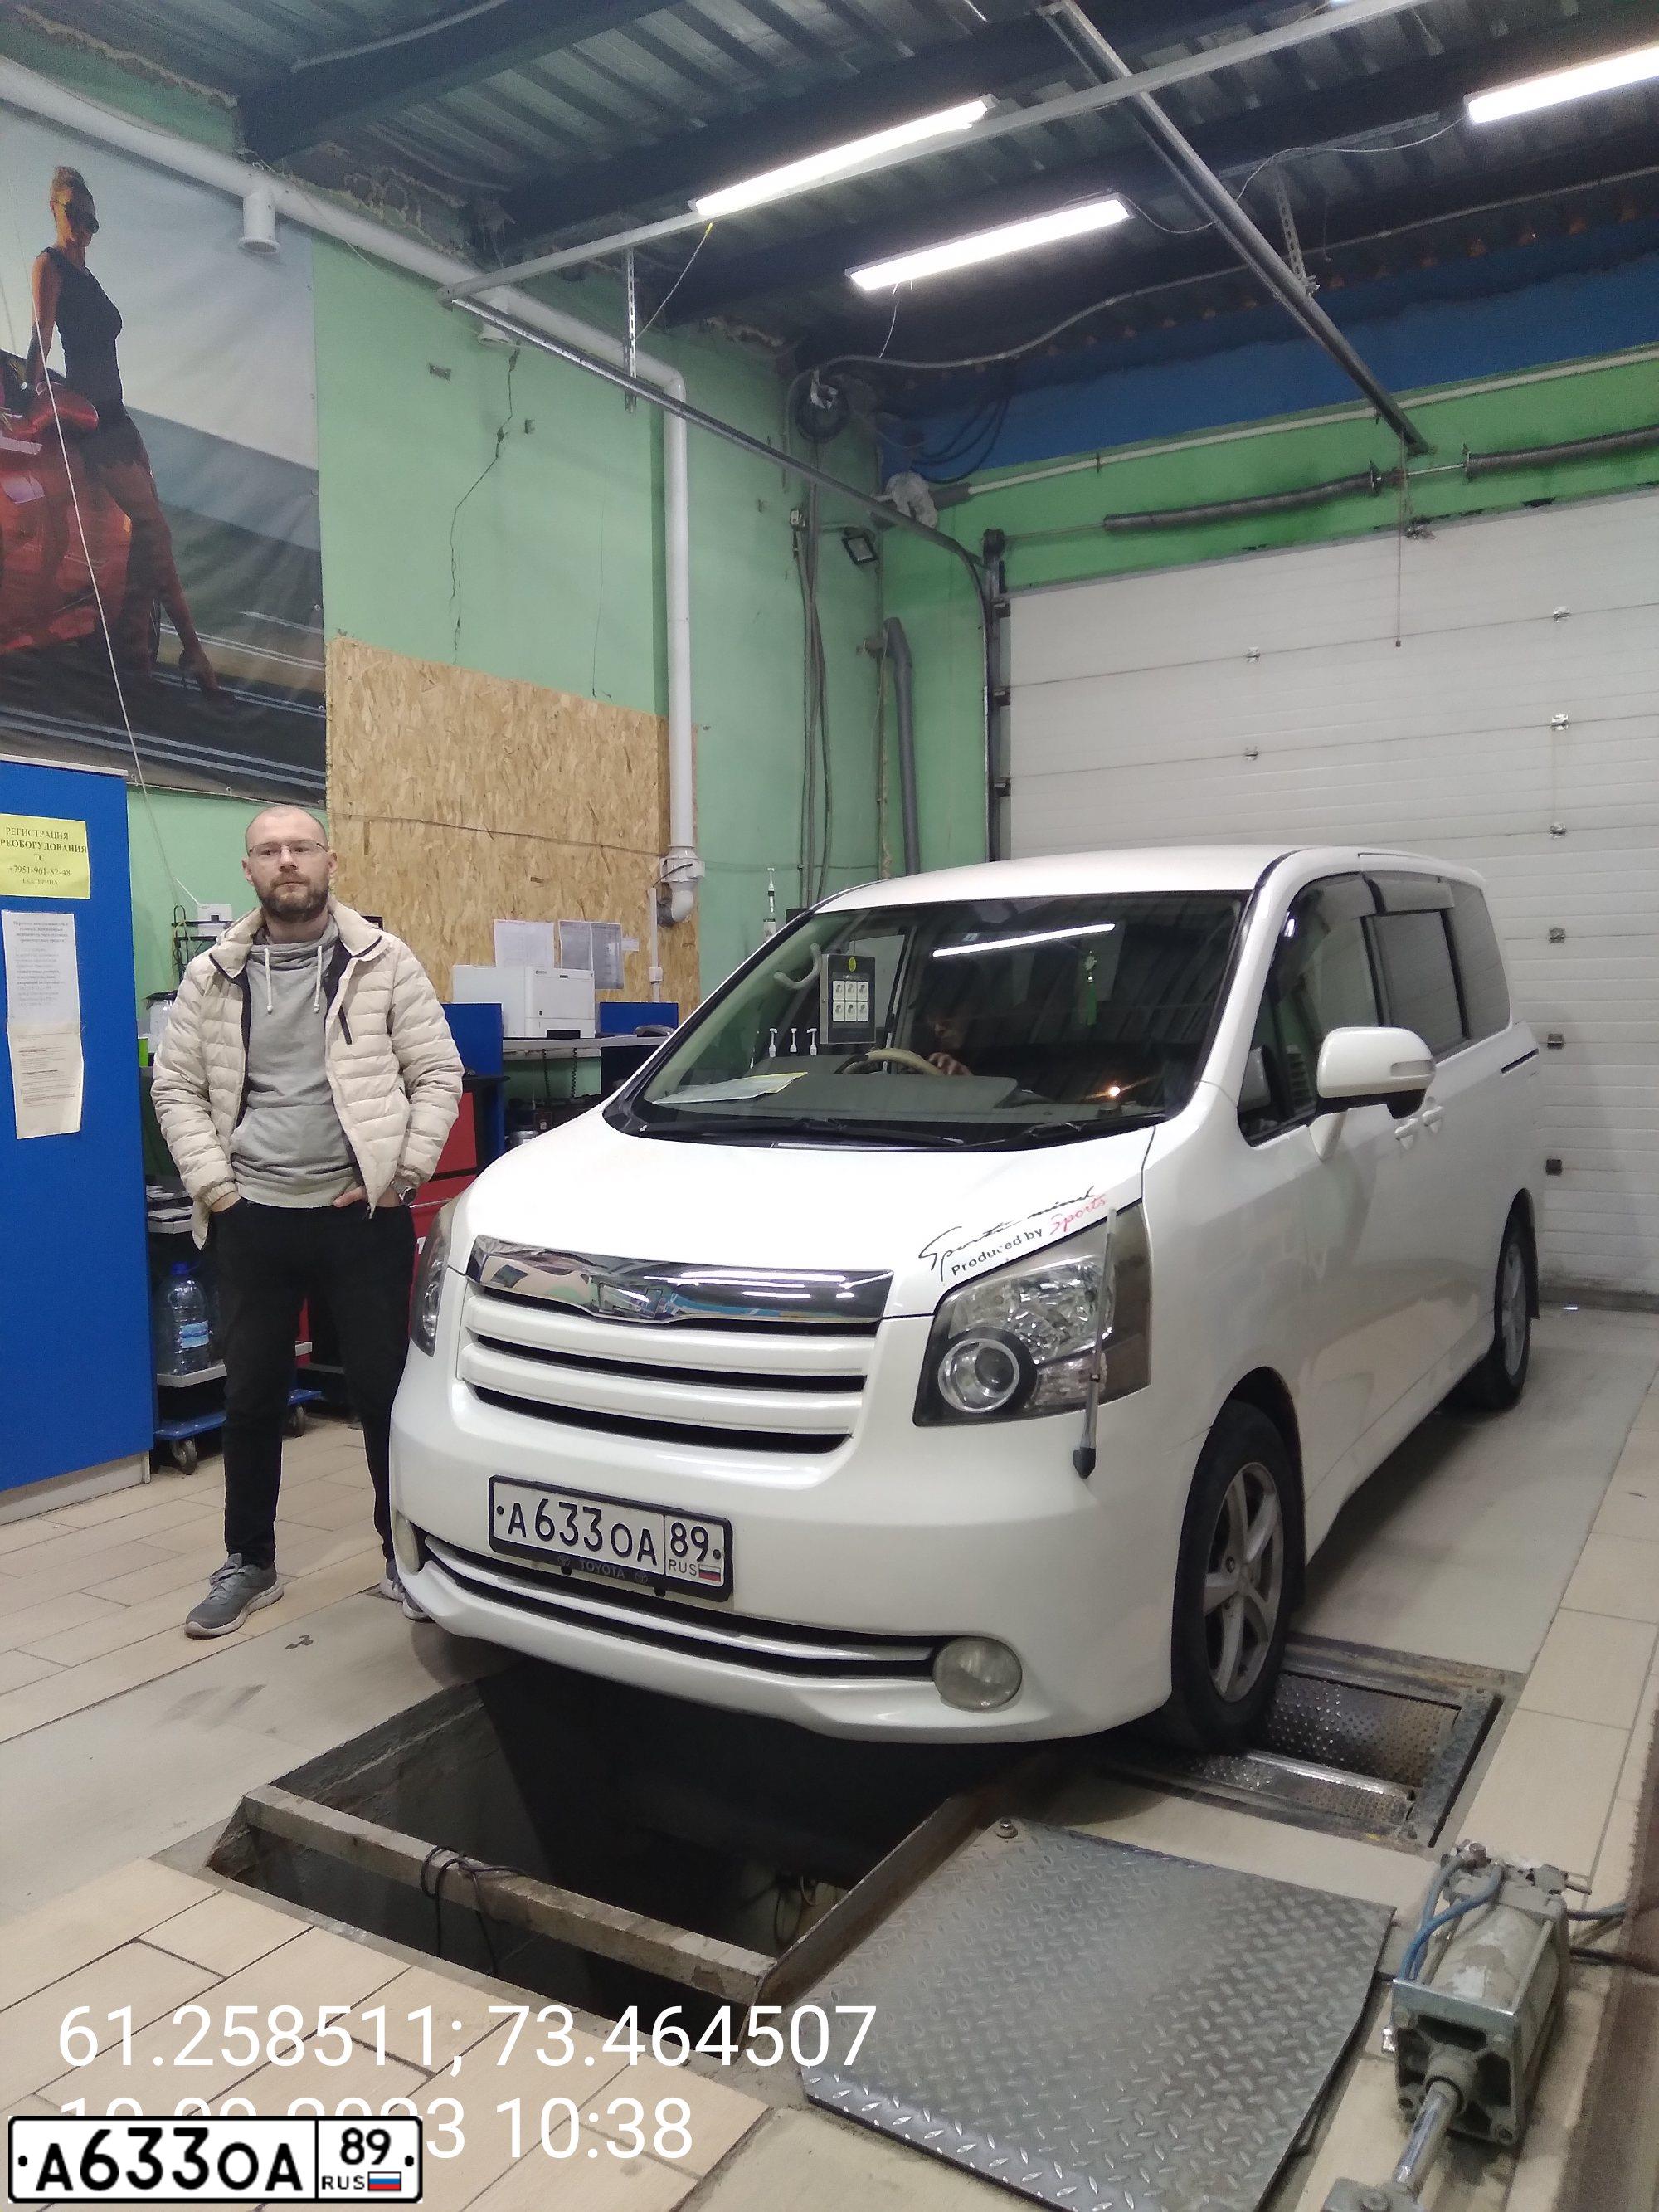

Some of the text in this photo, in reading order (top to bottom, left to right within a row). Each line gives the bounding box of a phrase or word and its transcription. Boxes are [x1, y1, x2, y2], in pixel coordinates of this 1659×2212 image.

[6, 826, 69, 840] РЕГИСТРАЦИЯ
[951, 1193, 1108, 1276] Produced by Sports
[508, 1498, 709, 1566] А633ОА 89
[580, 1560, 625, 1579] TOYOTA
[669, 1558, 698, 1576] RUS
